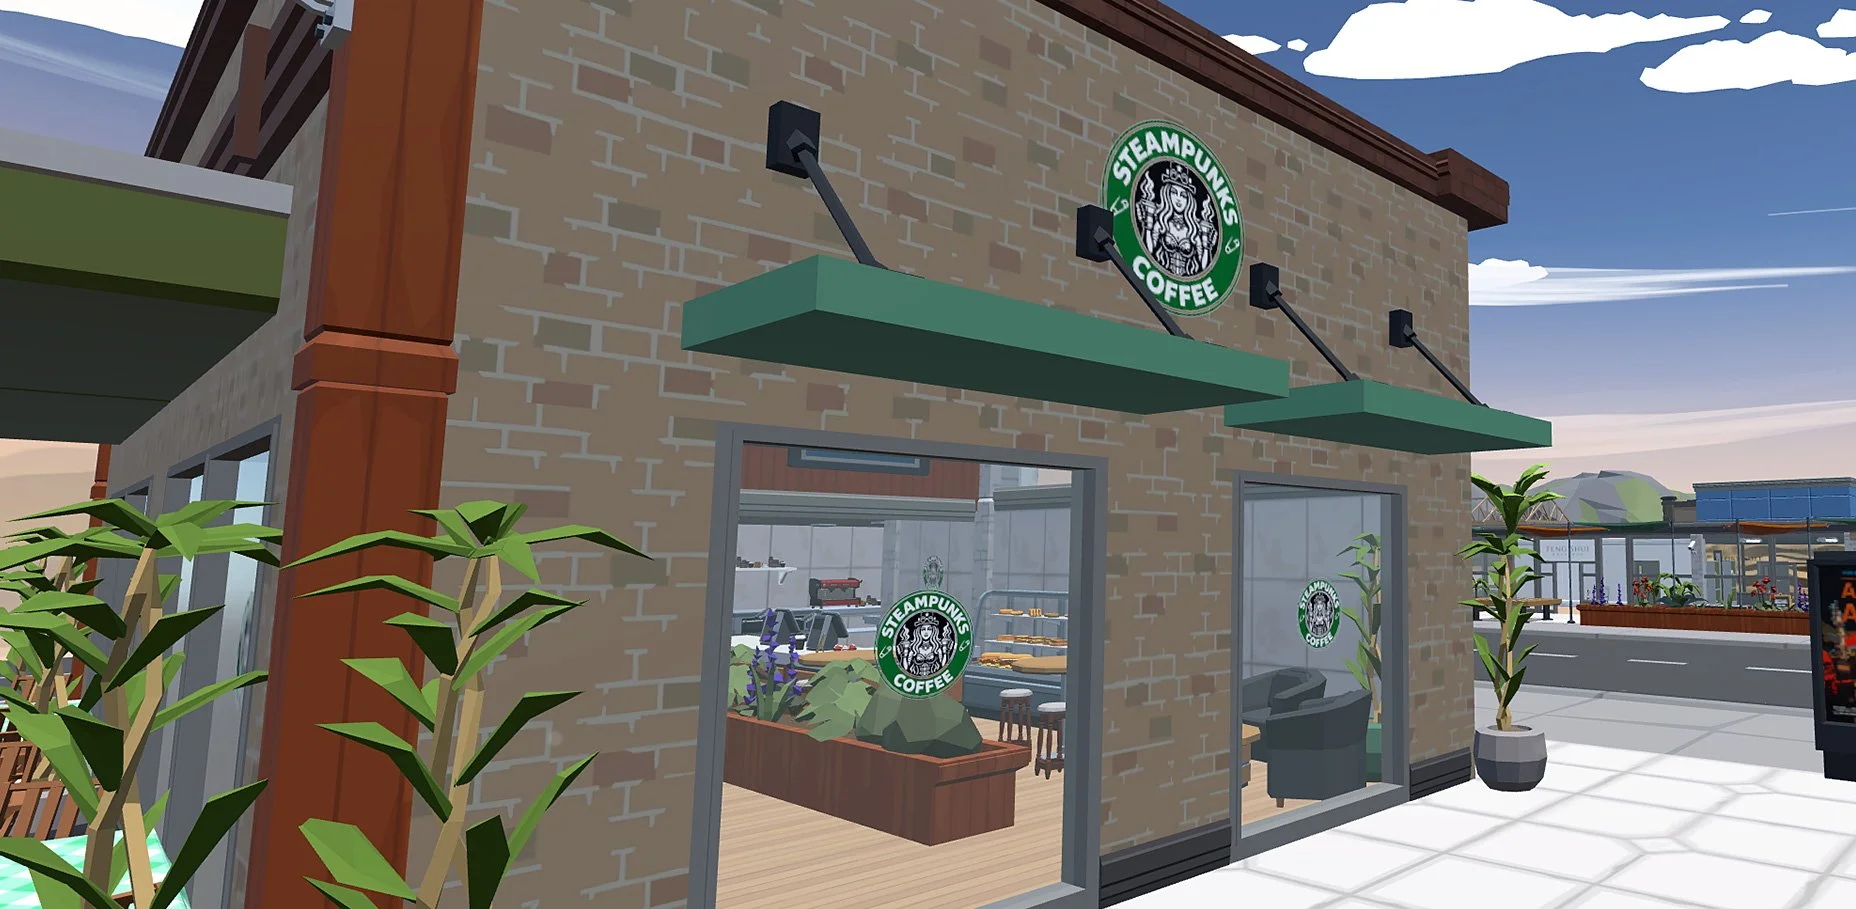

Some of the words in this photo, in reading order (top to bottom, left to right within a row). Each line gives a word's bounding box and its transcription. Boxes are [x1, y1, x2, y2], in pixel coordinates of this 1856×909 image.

[1112, 130, 1238, 226] STEAMPUNKS
[1132, 255, 1219, 307] COFFEE
[1300, 581, 1340, 610] STEAMPUNKS
[882, 595, 970, 639] STEAMPUNKS
[1306, 632, 1334, 648] COFFEE
[893, 669, 954, 694] COFFEE
